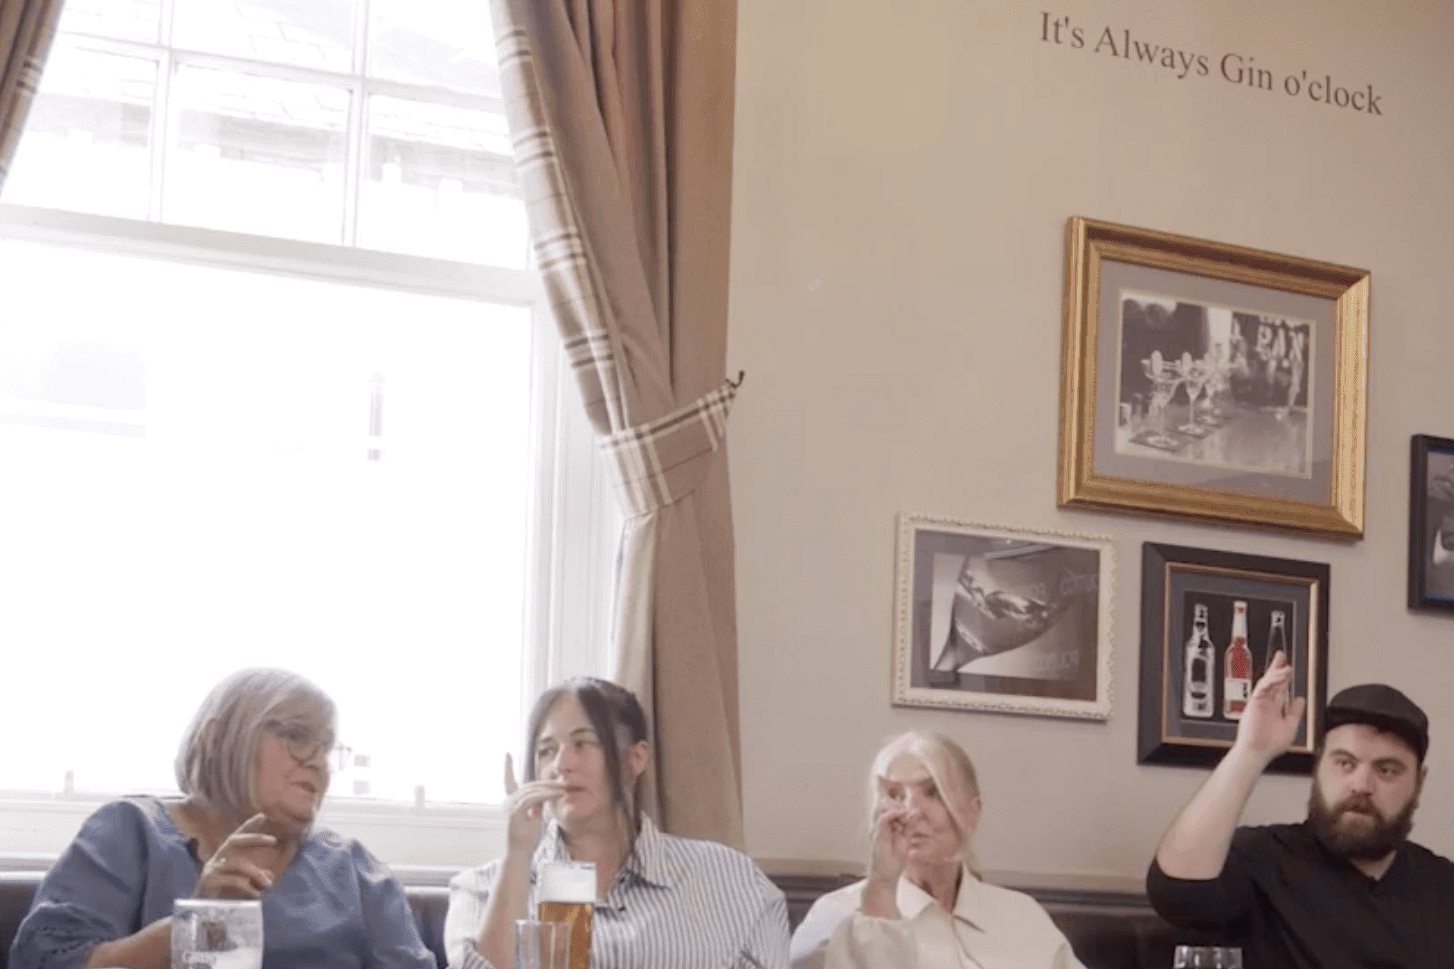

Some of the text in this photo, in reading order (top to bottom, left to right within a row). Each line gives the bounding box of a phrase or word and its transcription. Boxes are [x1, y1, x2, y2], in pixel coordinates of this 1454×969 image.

[1039, 11, 1383, 116] It's Always Gin o'clock
